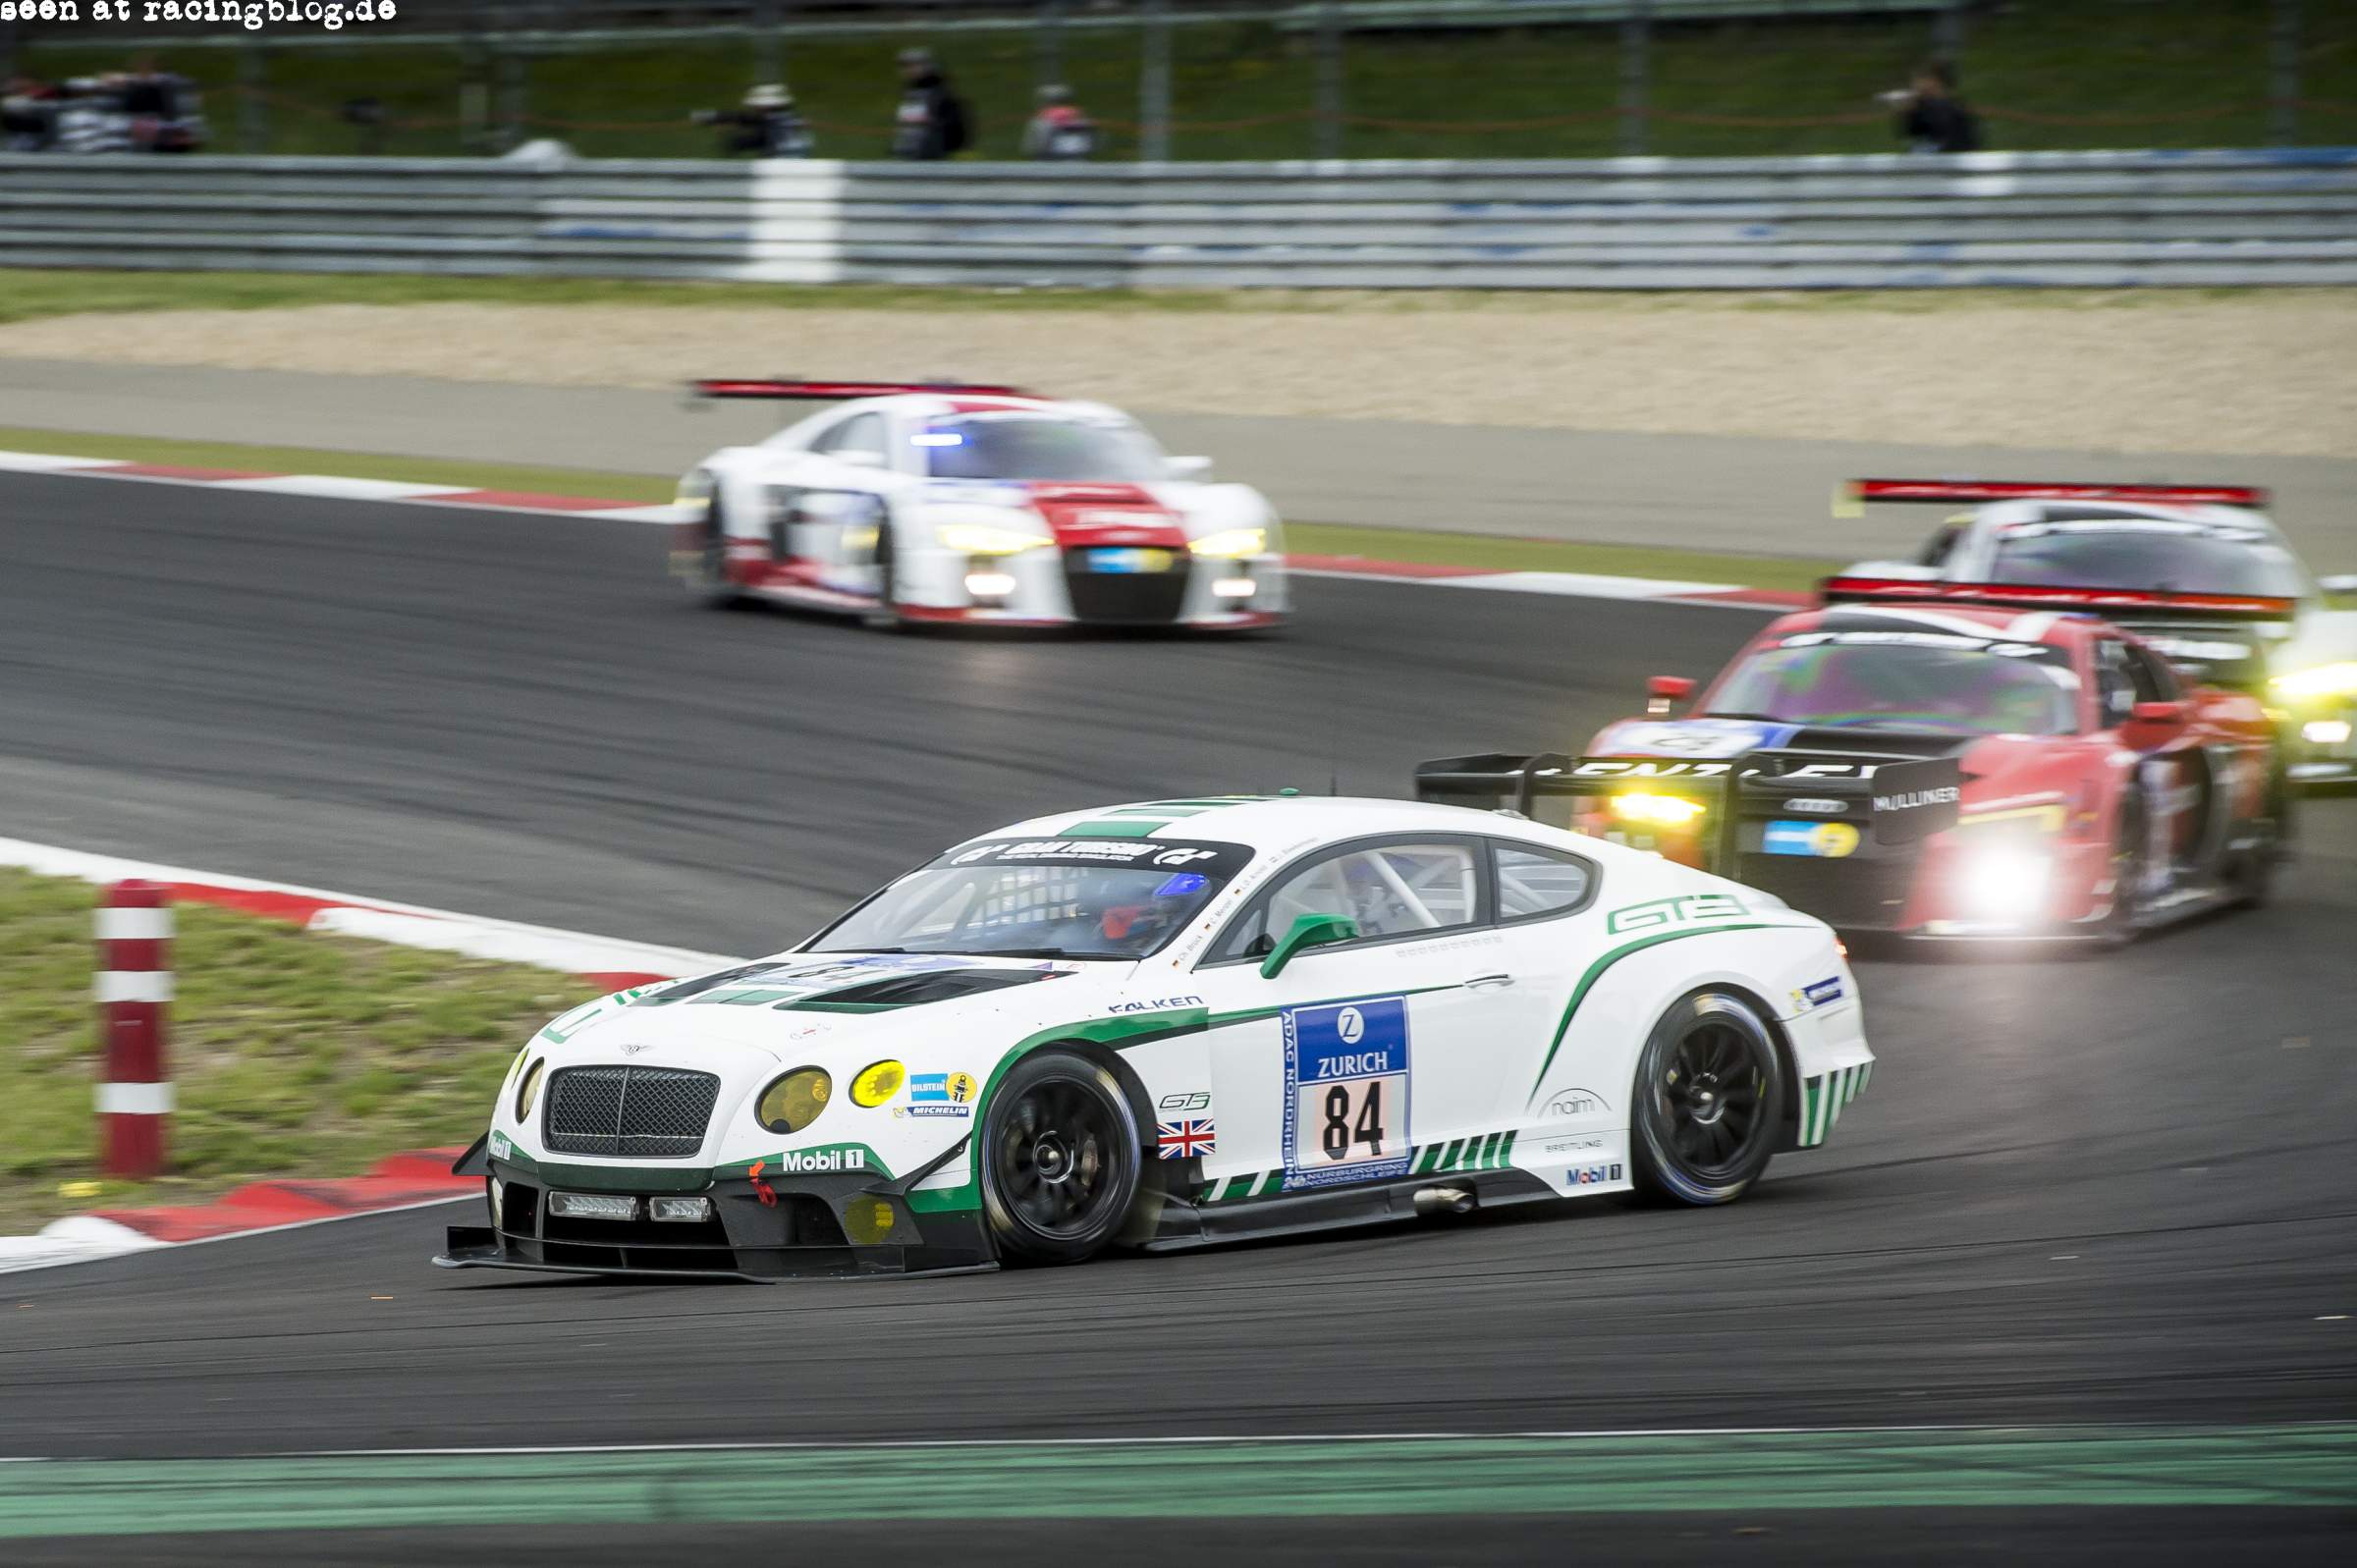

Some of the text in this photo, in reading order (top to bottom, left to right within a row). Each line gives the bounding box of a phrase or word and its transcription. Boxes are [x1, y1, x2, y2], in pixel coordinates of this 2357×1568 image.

[1108, 996, 1204, 1013] FALKEN
[1283, 1011, 1294, 1062] ADAC
[1318, 1051, 1388, 1078] ZURICH
[1159, 1092, 1211, 1110] GT3
[1284, 1069, 1295, 1175] NORDRHEIN
[1323, 1081, 1384, 1160] 84
[783, 1150, 841, 1171] Mobil
[1566, 1165, 1607, 1186] Mobil
